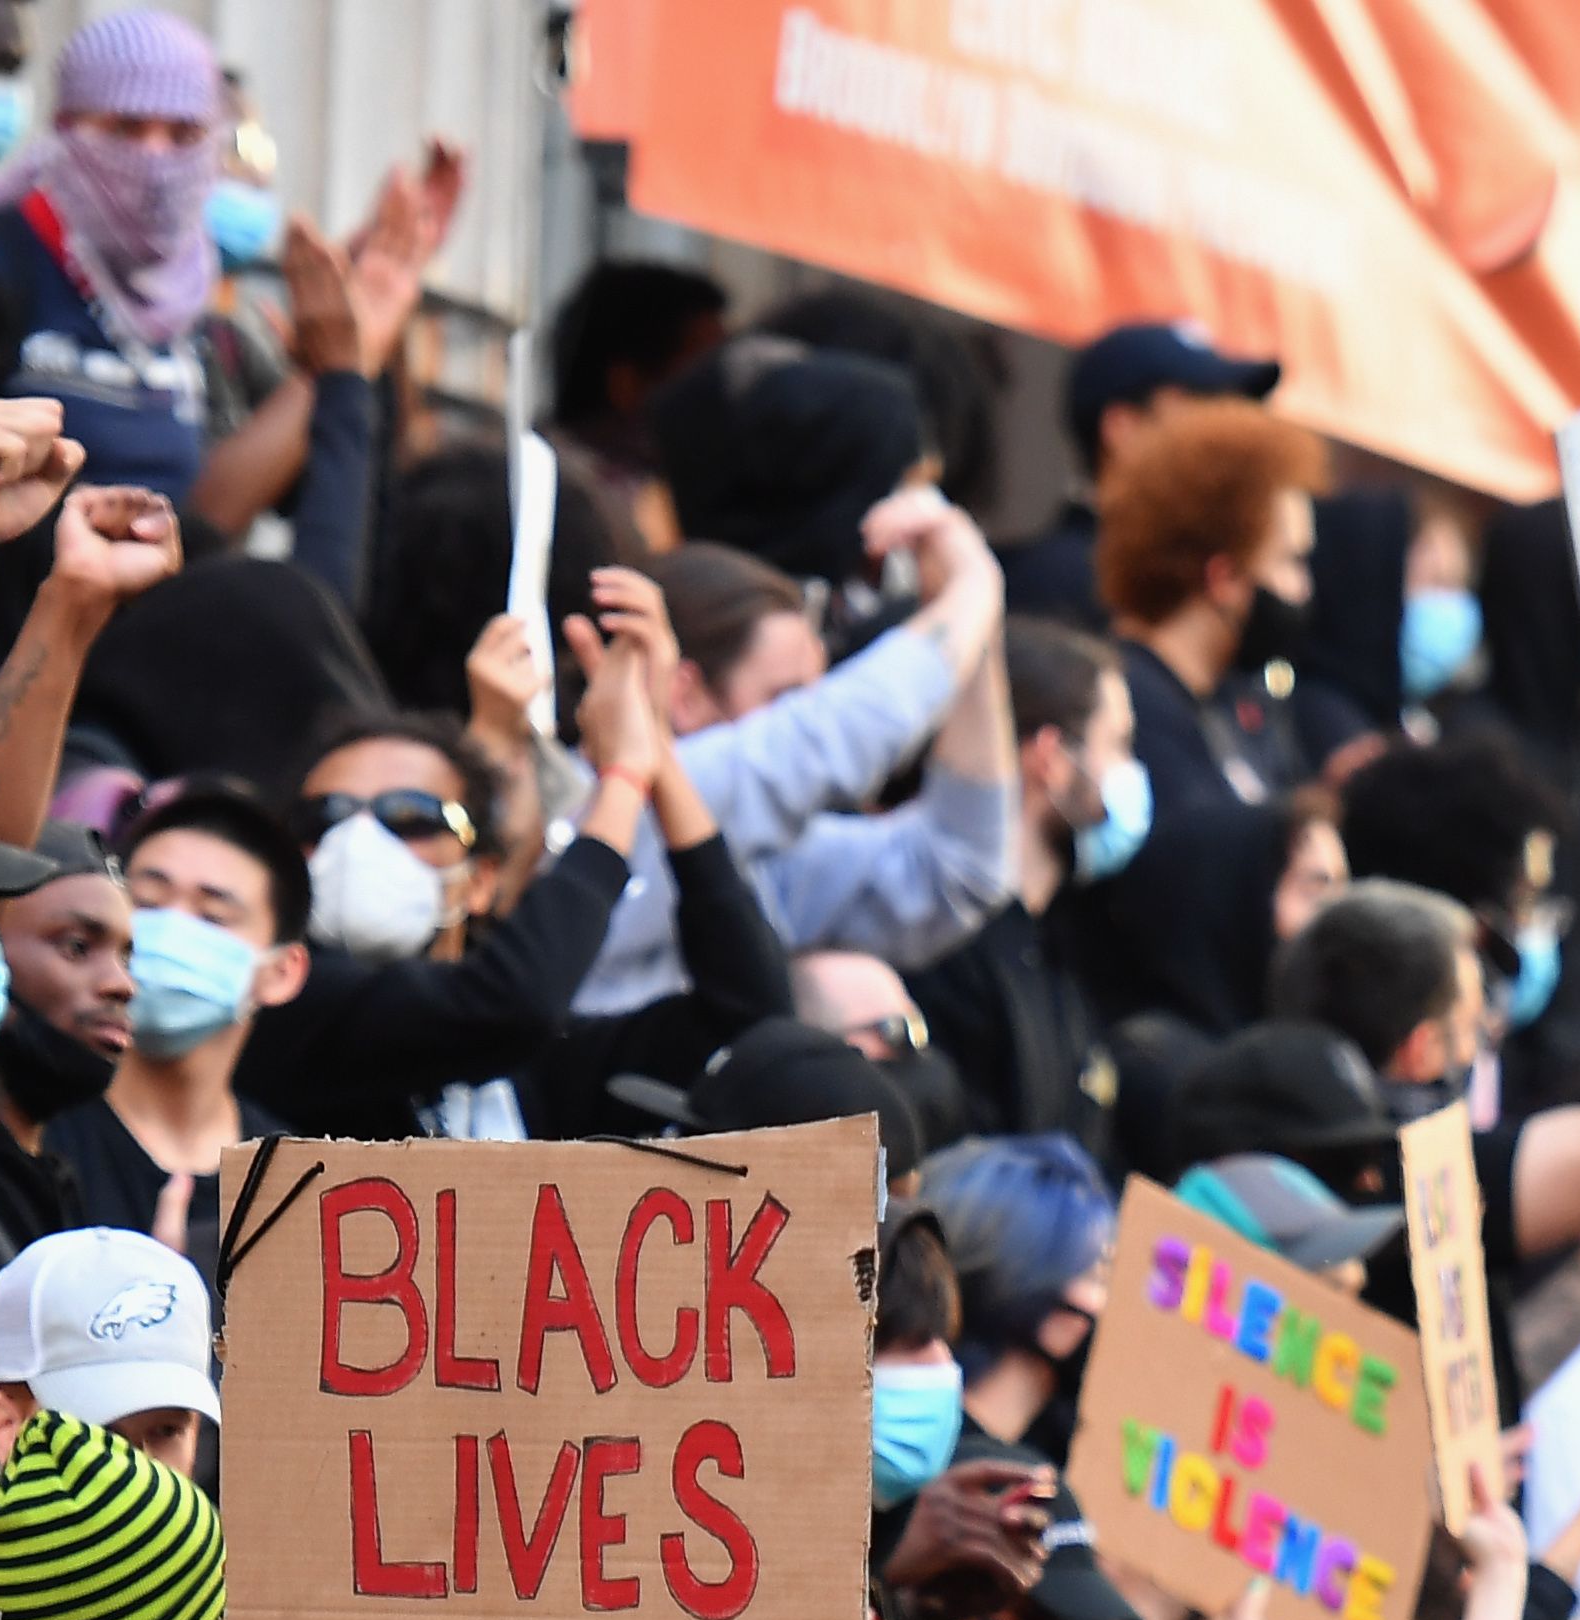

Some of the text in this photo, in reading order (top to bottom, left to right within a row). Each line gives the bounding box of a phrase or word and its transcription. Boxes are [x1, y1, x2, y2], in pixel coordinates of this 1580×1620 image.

[319, 1176, 796, 1395] BLACK
[1148, 1236, 1398, 1437] SILENCE
[1210, 1385, 1275, 1470] IS
